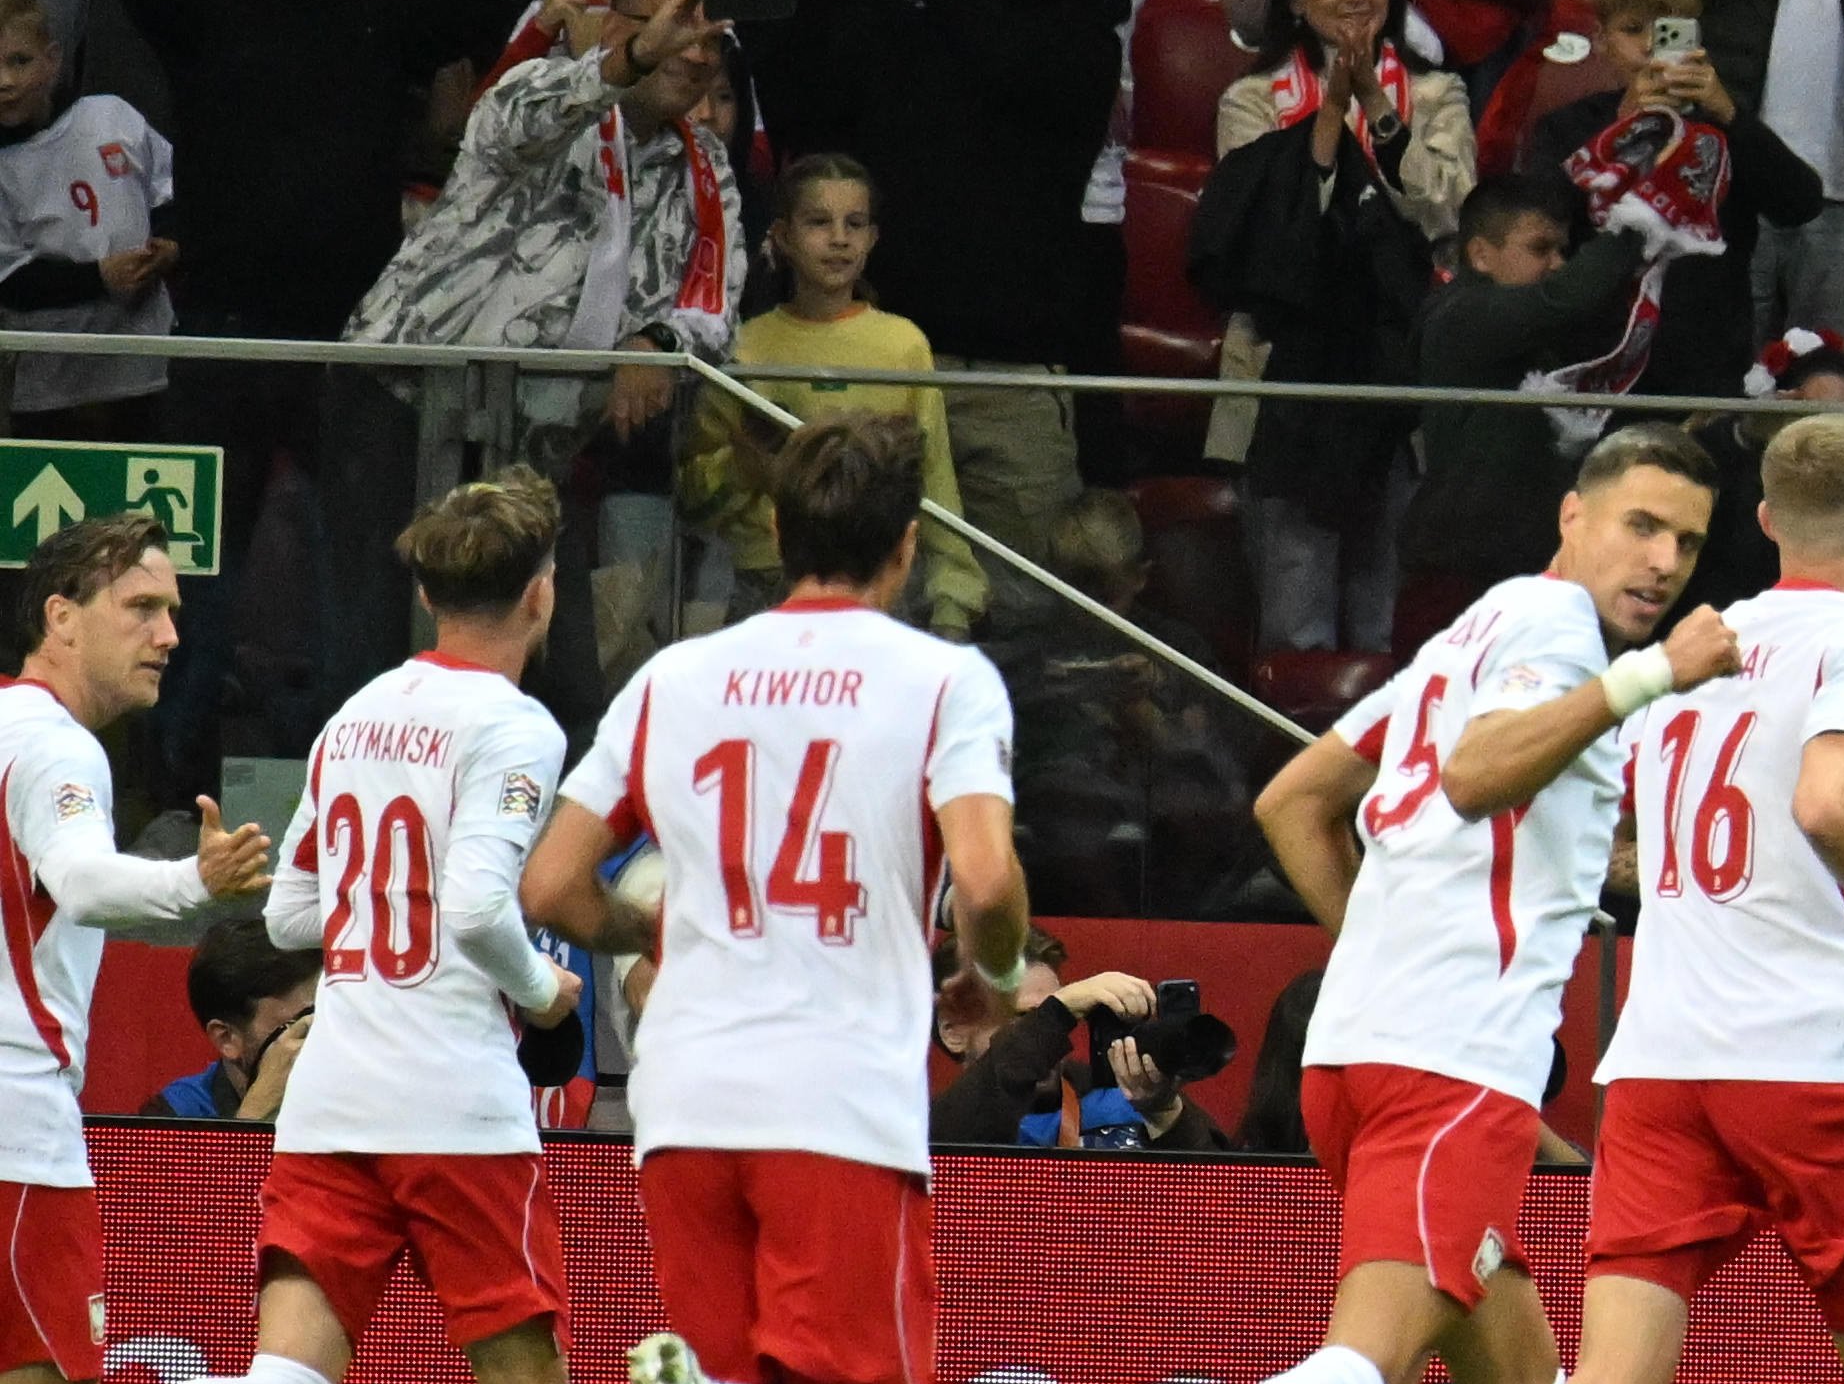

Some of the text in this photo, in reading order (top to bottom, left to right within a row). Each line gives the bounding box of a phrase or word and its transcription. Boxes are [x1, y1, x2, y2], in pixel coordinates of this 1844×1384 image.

[69, 180, 99, 227] 9
[328, 717, 455, 769] SZYMAŃSKI
[723, 668, 863, 708] KIWIOR
[1363, 672, 1449, 844] 5
[323, 791, 441, 990] 20
[692, 738, 868, 948] 14
[1657, 708, 1758, 905] 16
